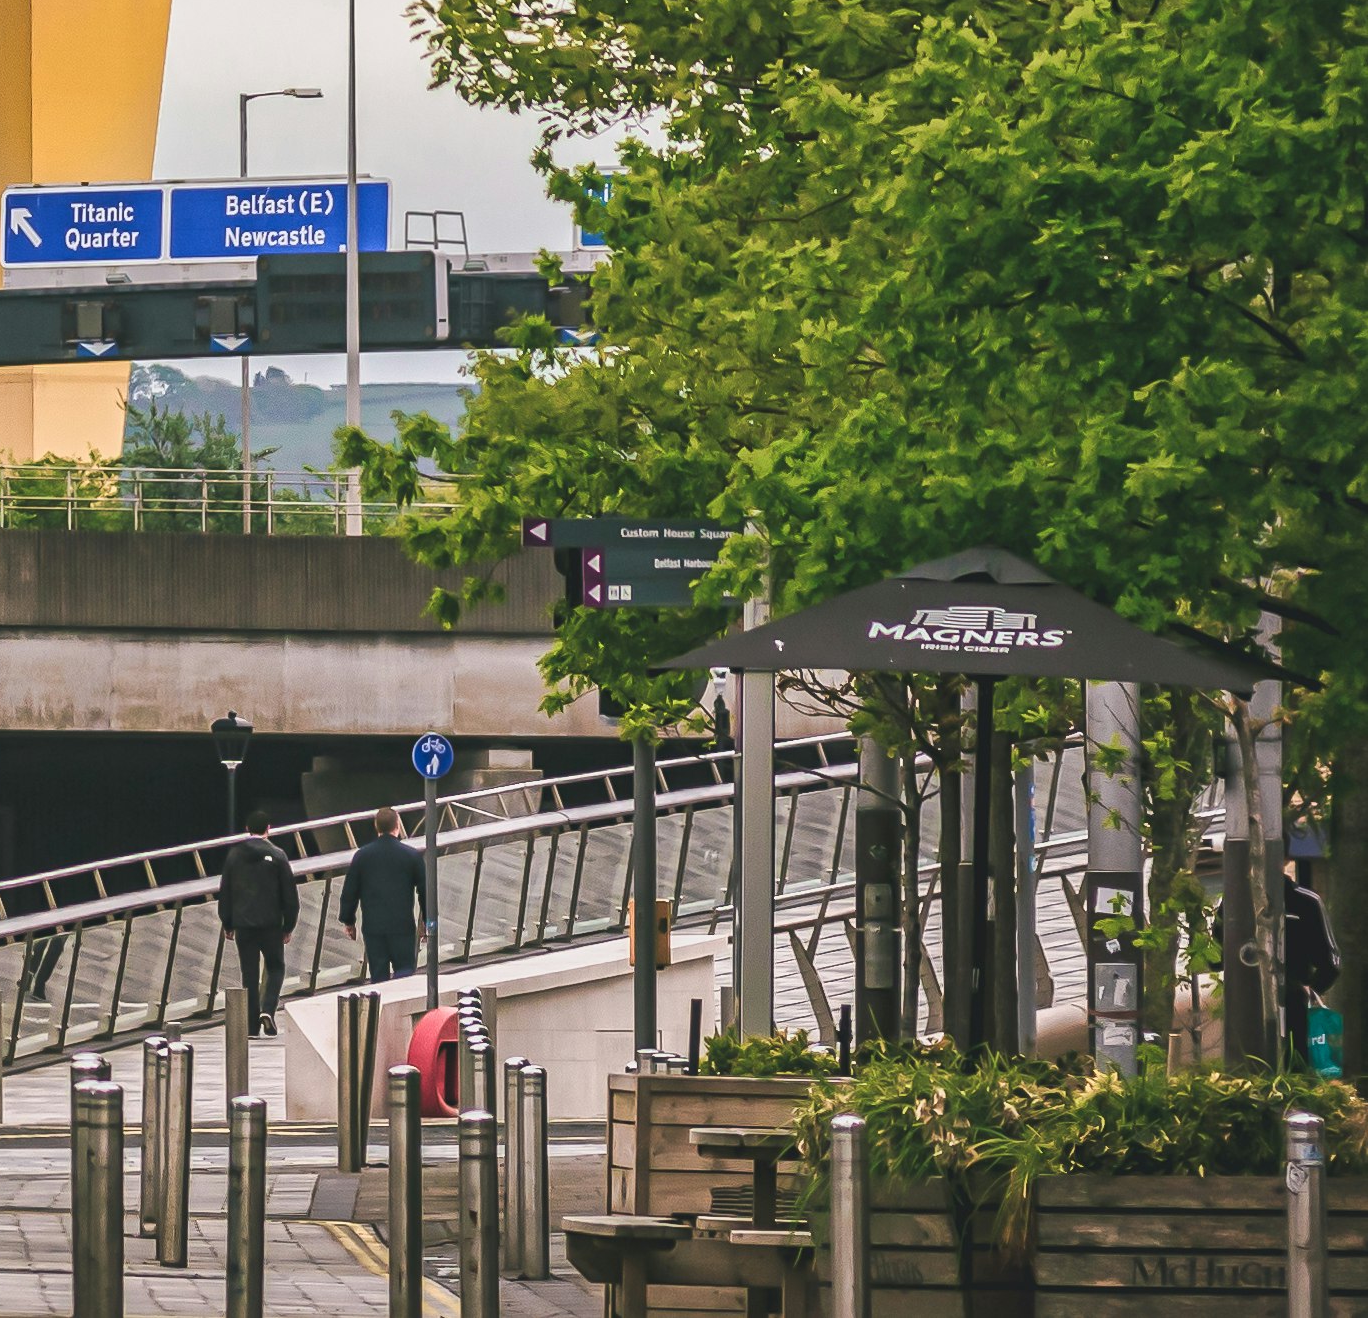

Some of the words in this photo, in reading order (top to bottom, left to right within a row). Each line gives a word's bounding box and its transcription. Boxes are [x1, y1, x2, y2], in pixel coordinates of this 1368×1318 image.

[71, 201, 134, 225] Titanic
[225, 192, 295, 216] Belfast
[299, 189, 334, 216] (E)
[65, 227, 139, 251] Quarter
[224, 225, 326, 248] Newcastle
[620, 527, 659, 538] Custom
[663, 527, 695, 538] House
[699, 528, 734, 540] Squar
[654, 558, 681, 569] Belfast
[868, 621, 1065, 647] MAGNERS
[920, 643, 960, 652] IRISH
[963, 646, 1010, 654] CIDER
